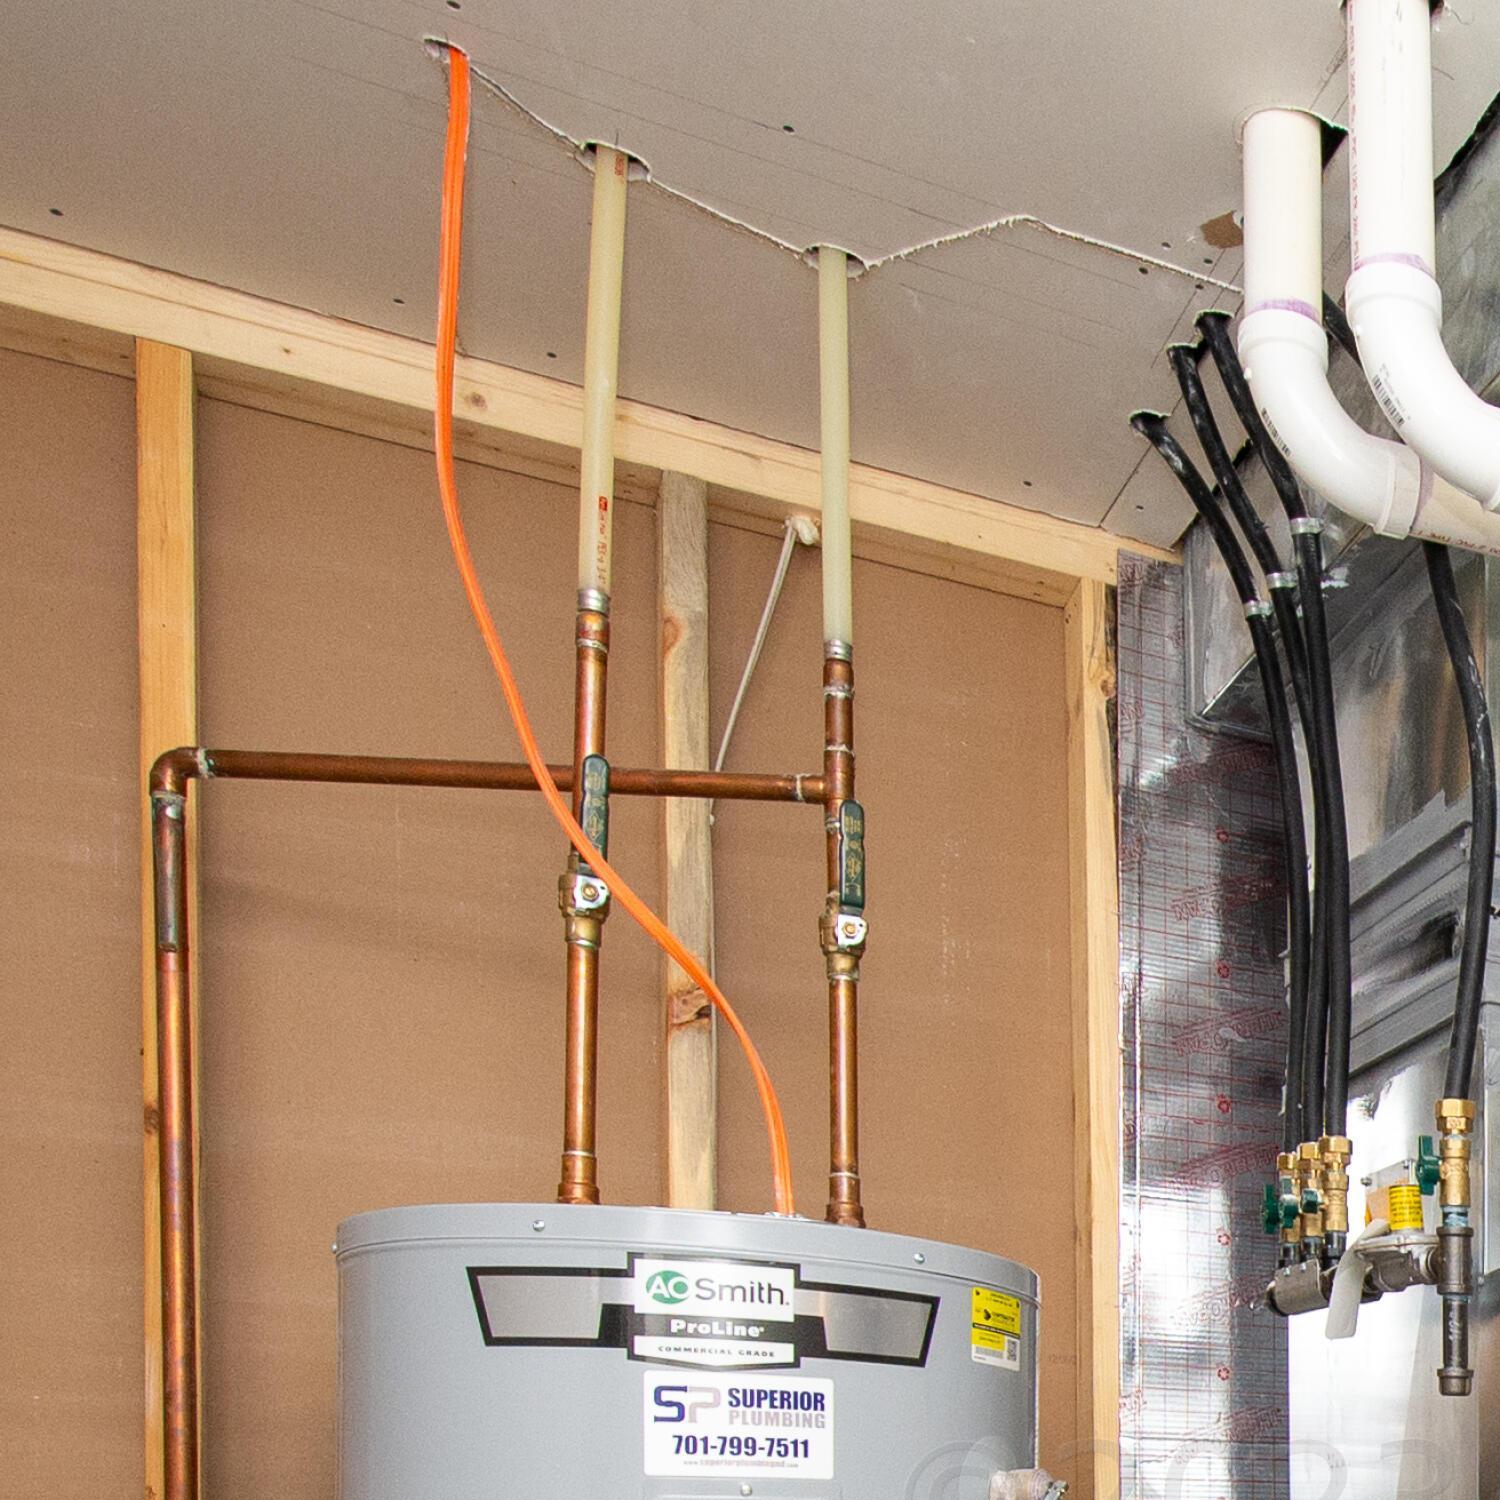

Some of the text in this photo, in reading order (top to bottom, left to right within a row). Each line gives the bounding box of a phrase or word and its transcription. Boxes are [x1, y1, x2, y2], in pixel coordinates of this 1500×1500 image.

[695, 1277, 785, 1306] Smith
[658, 1345, 775, 1358] COMMERCIAL GRADE
[727, 1387, 825, 1412] SUPERIOR
[728, 1409, 826, 1429] PLUMBING
[672, 1434, 810, 1459] 701-799-7511
